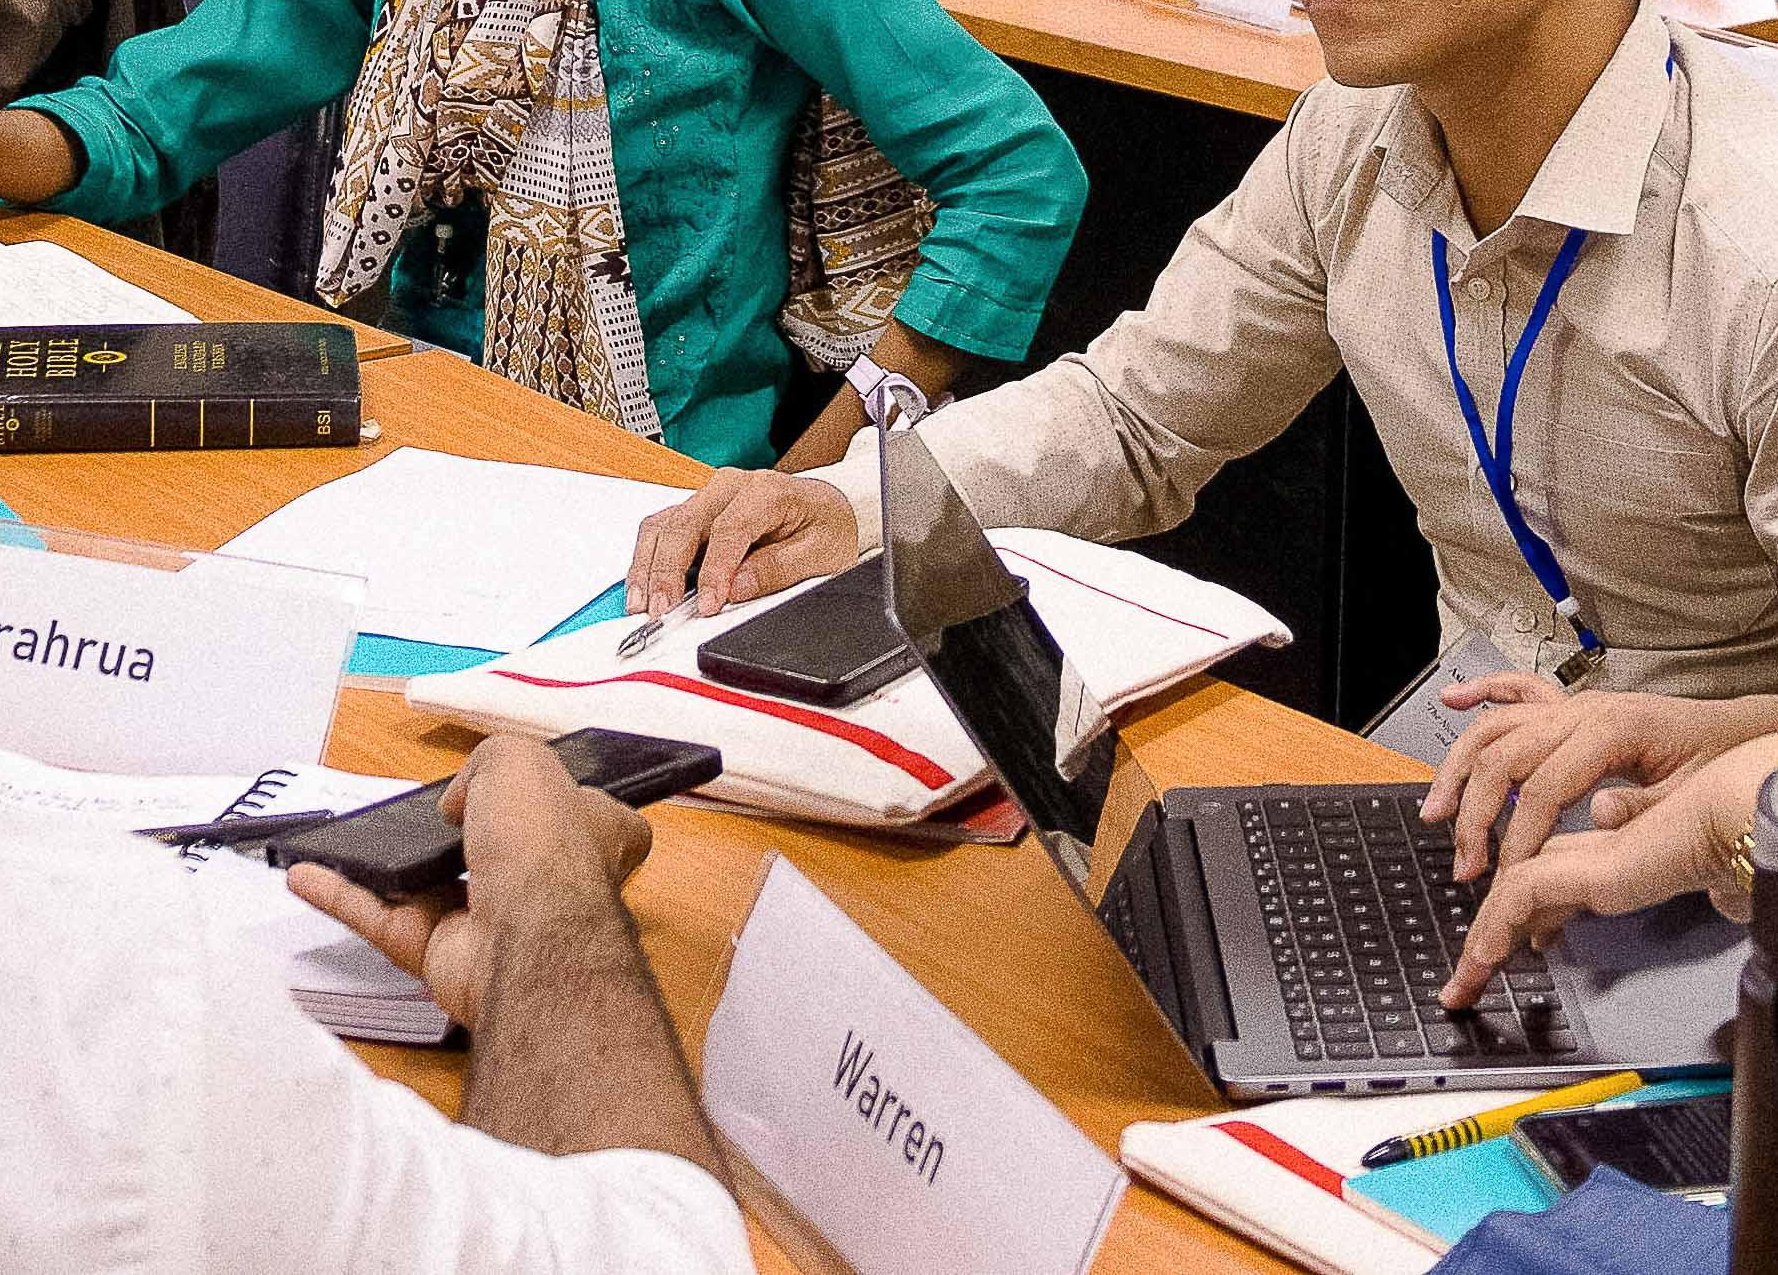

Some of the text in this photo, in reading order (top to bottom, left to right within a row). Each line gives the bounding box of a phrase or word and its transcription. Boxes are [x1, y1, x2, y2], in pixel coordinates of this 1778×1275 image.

[6, 340, 40, 379] HOLY
[46, 338, 79, 378] BIBLE
[317, 410, 331, 436] BSI
[834, 1030, 944, 1184] Warren
